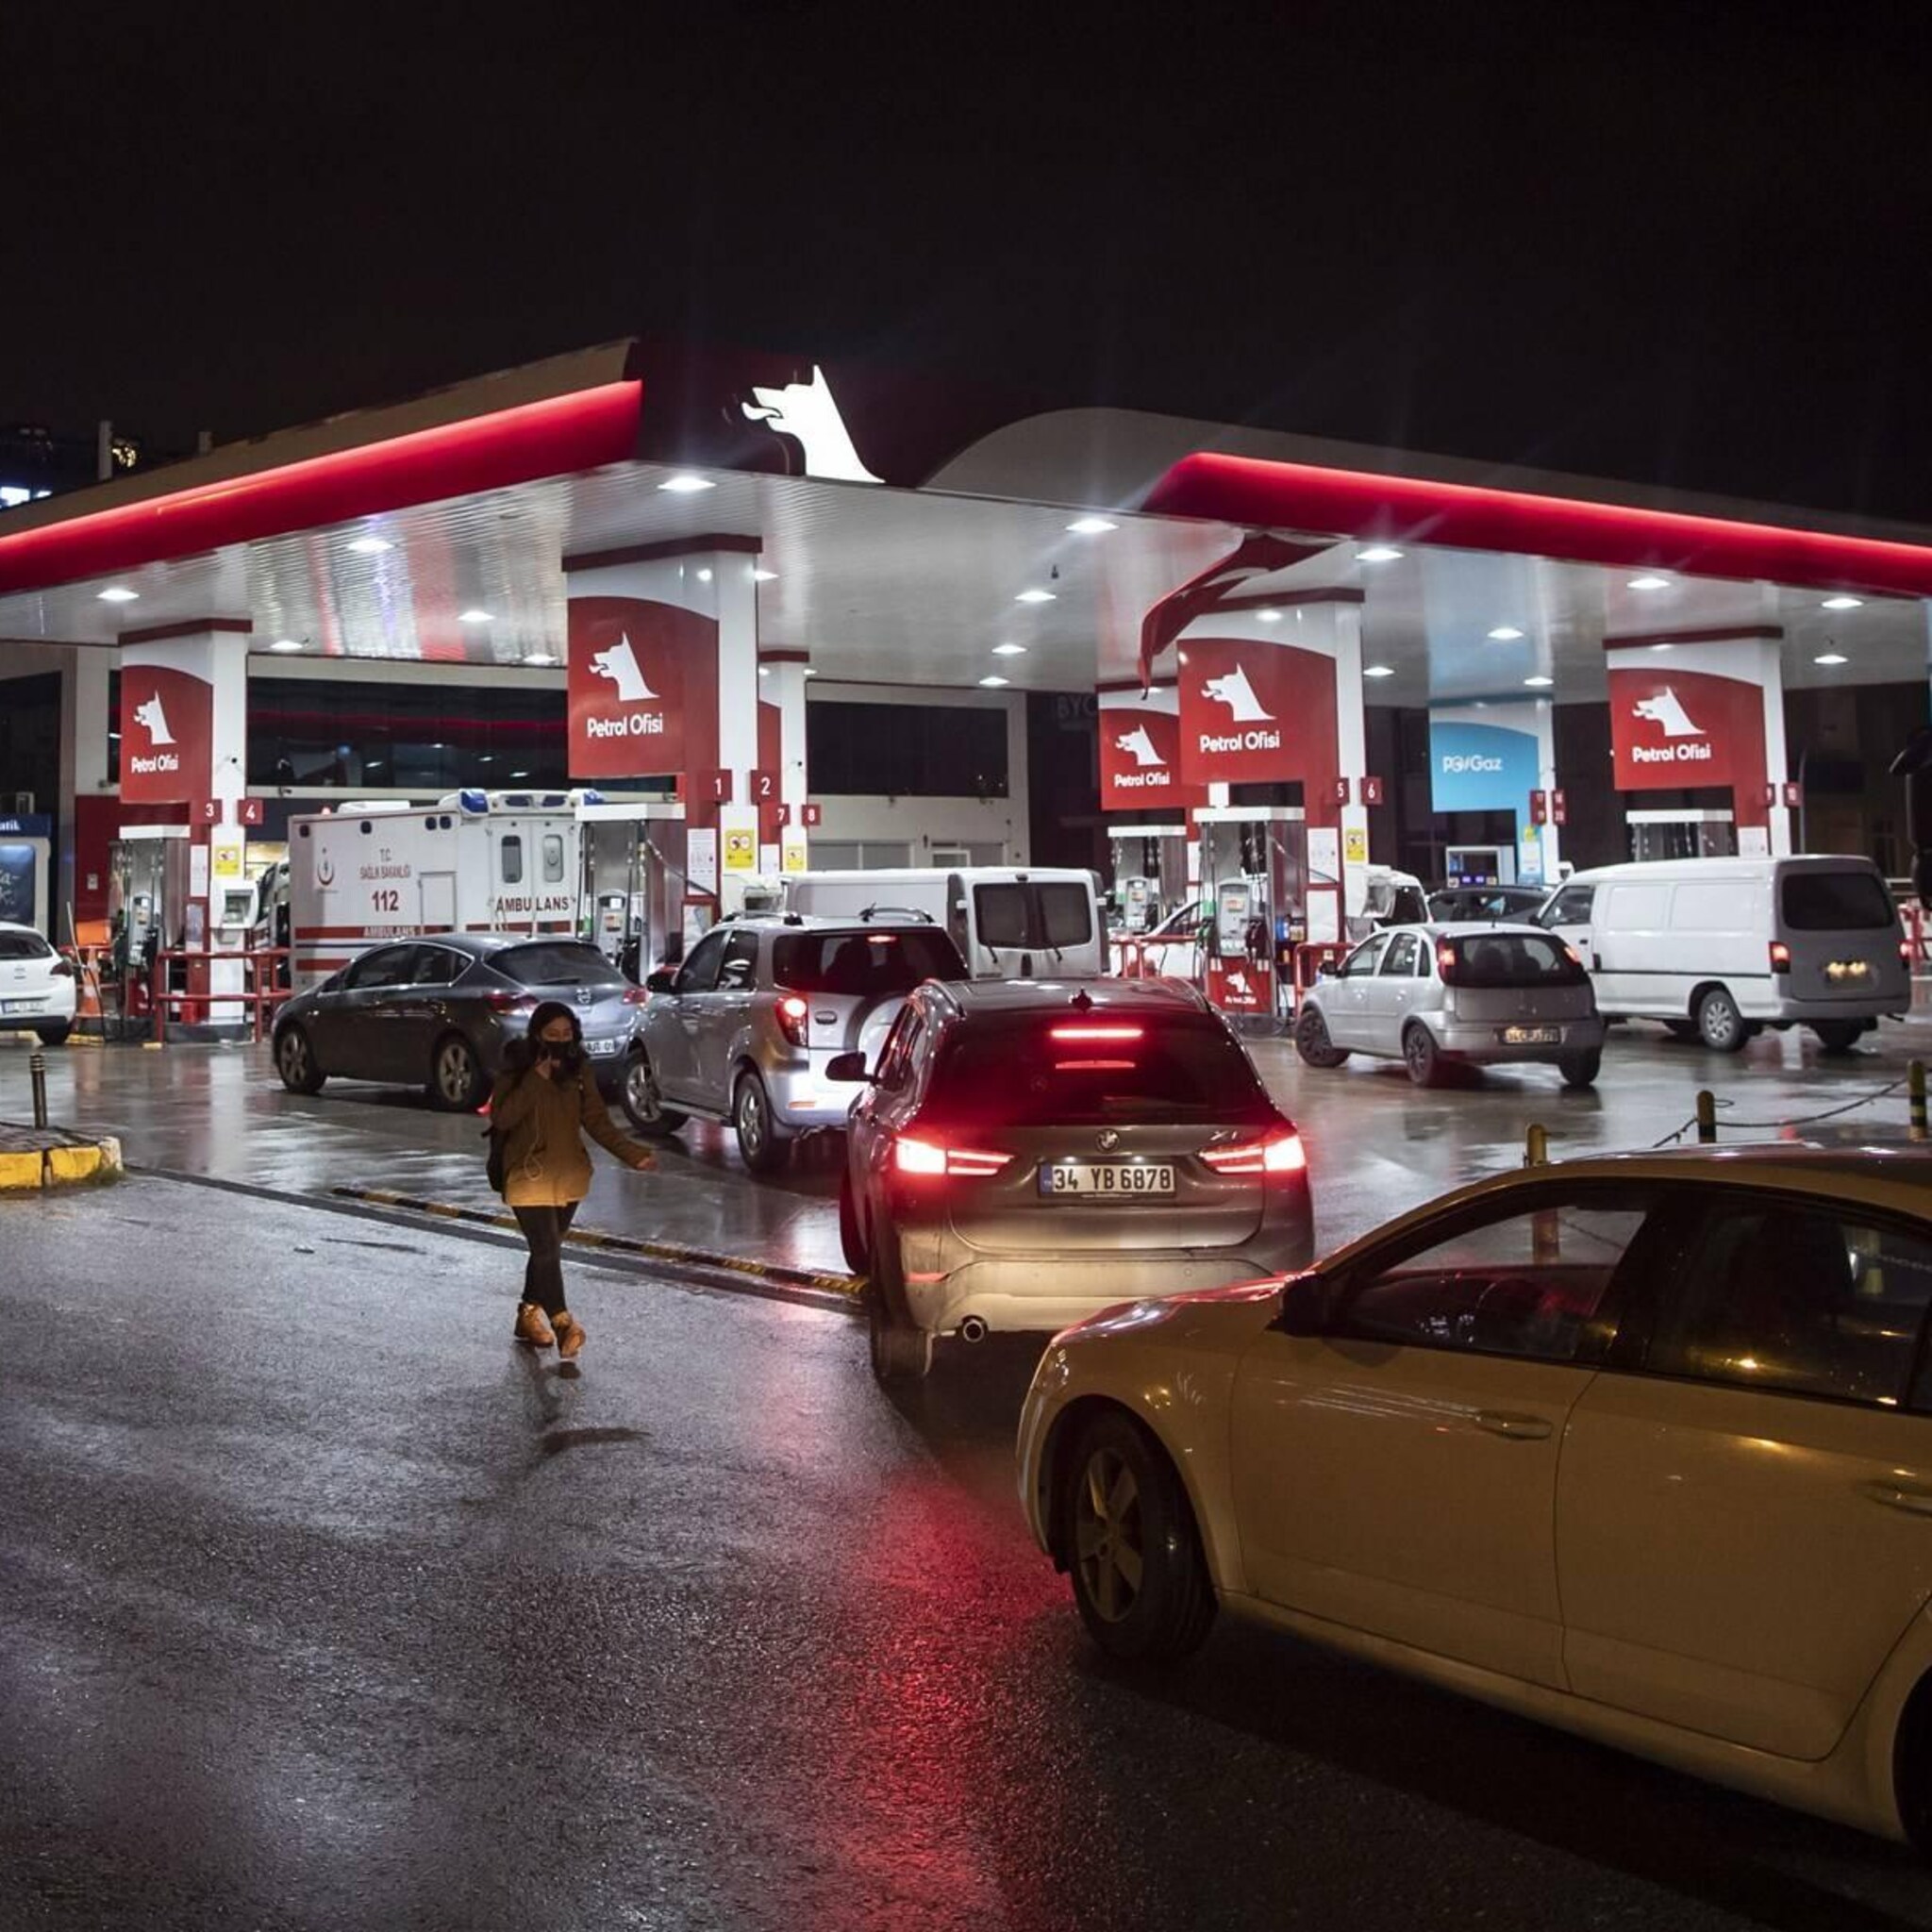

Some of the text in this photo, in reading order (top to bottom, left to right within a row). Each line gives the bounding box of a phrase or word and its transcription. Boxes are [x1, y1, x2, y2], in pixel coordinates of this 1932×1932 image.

[587, 712, 663, 738] Petrol Ofisi
[1199, 730, 1280, 753] Petrol Ofisi
[1632, 743, 1711, 762] Petrol Ofisi
[131, 754, 178, 774] Petrol Ofisi
[714, 778, 722, 795] 1
[760, 776, 771, 795] 2
[1114, 772, 1170, 788] Petrol Ofisi
[1337, 782, 1344, 798] 5
[1368, 783, 1375, 799] 6
[206, 803, 214, 818] 3
[245, 805, 256, 819] 4
[777, 808, 785, 822] 7
[808, 808, 815, 822] 8
[372, 890, 399, 913] 112
[1054, 1168, 1171, 1190] 34 YB 6878
